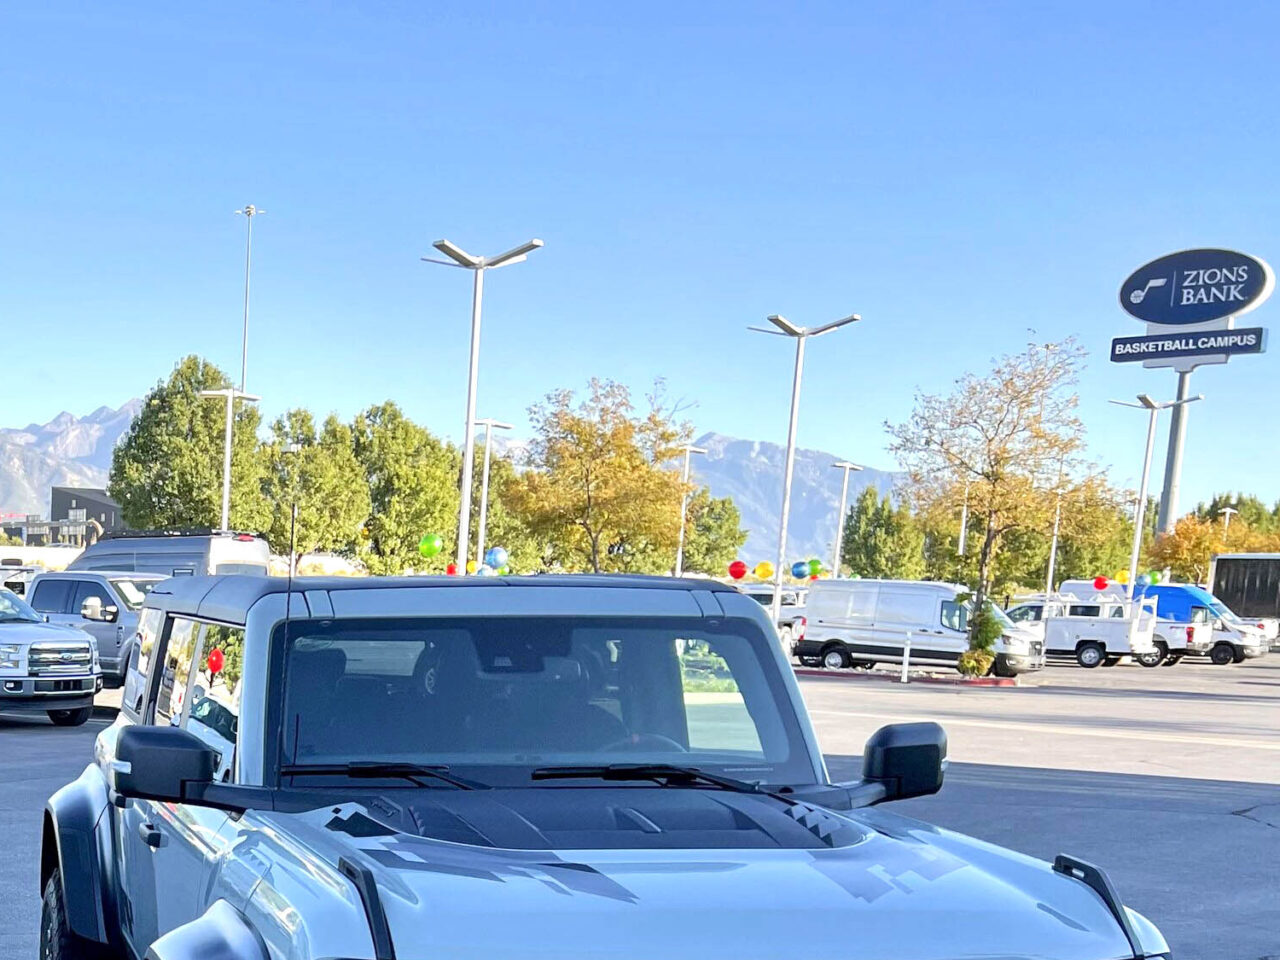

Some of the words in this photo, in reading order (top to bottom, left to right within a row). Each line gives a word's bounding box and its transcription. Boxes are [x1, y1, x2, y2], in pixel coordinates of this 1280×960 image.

[1182, 266, 1249, 287] ZIONS
[1180, 284, 1246, 306] BANK
[1115, 338, 1197, 355] BASKETBALL
[1198, 334, 1256, 349] CAMPUS
